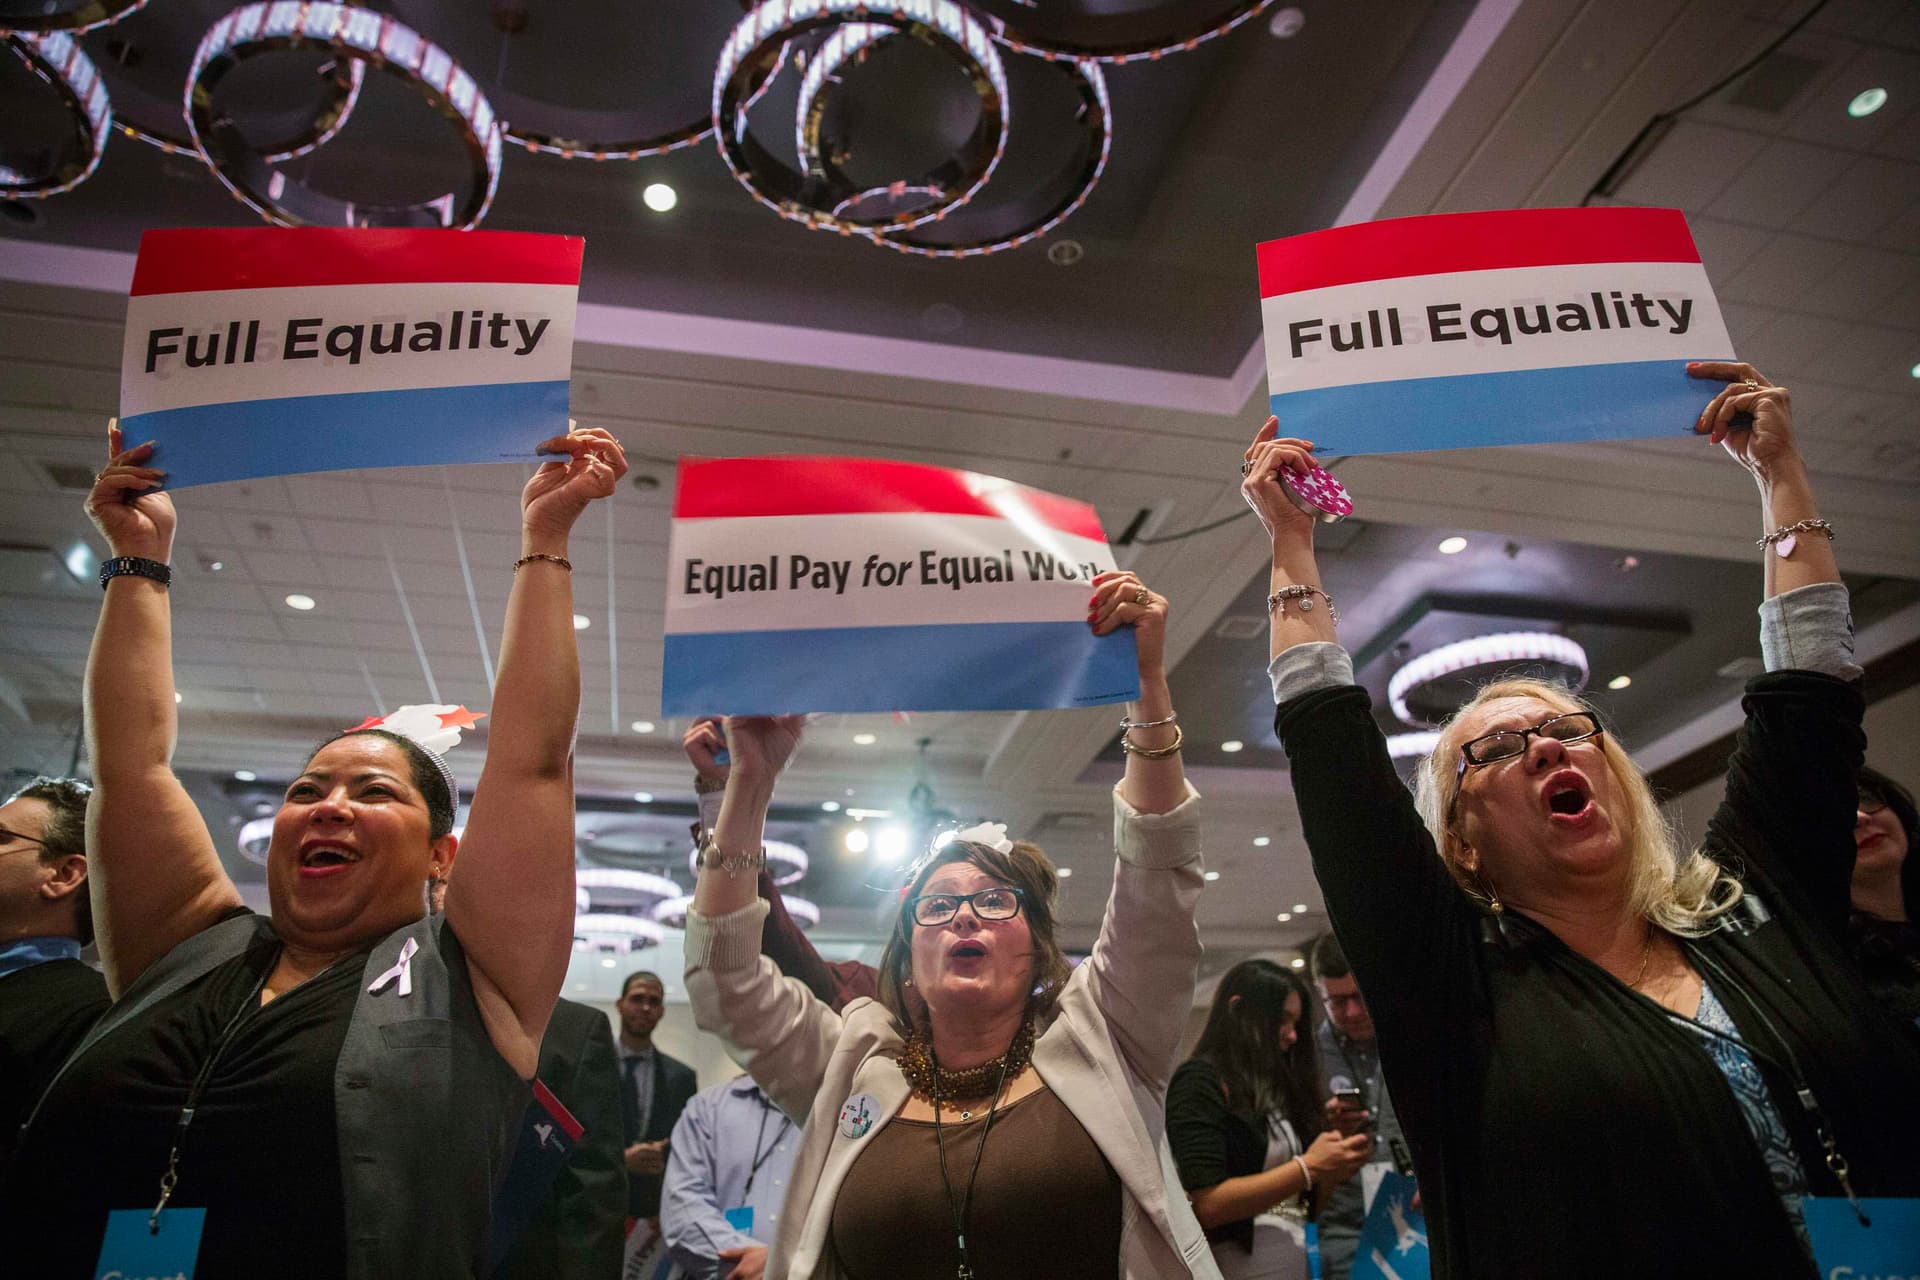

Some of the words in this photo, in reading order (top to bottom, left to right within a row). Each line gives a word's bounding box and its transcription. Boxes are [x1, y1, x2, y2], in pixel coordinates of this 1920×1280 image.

[145, 319, 260, 373] Full
[283, 310, 552, 364] Equality
[1289, 307, 1403, 358] Full
[1426, 291, 1693, 345] Equality
[685, 555, 778, 598] Equal
[789, 554, 851, 595] Pay
[862, 553, 912, 588] for
[919, 549, 1014, 590] Equal
